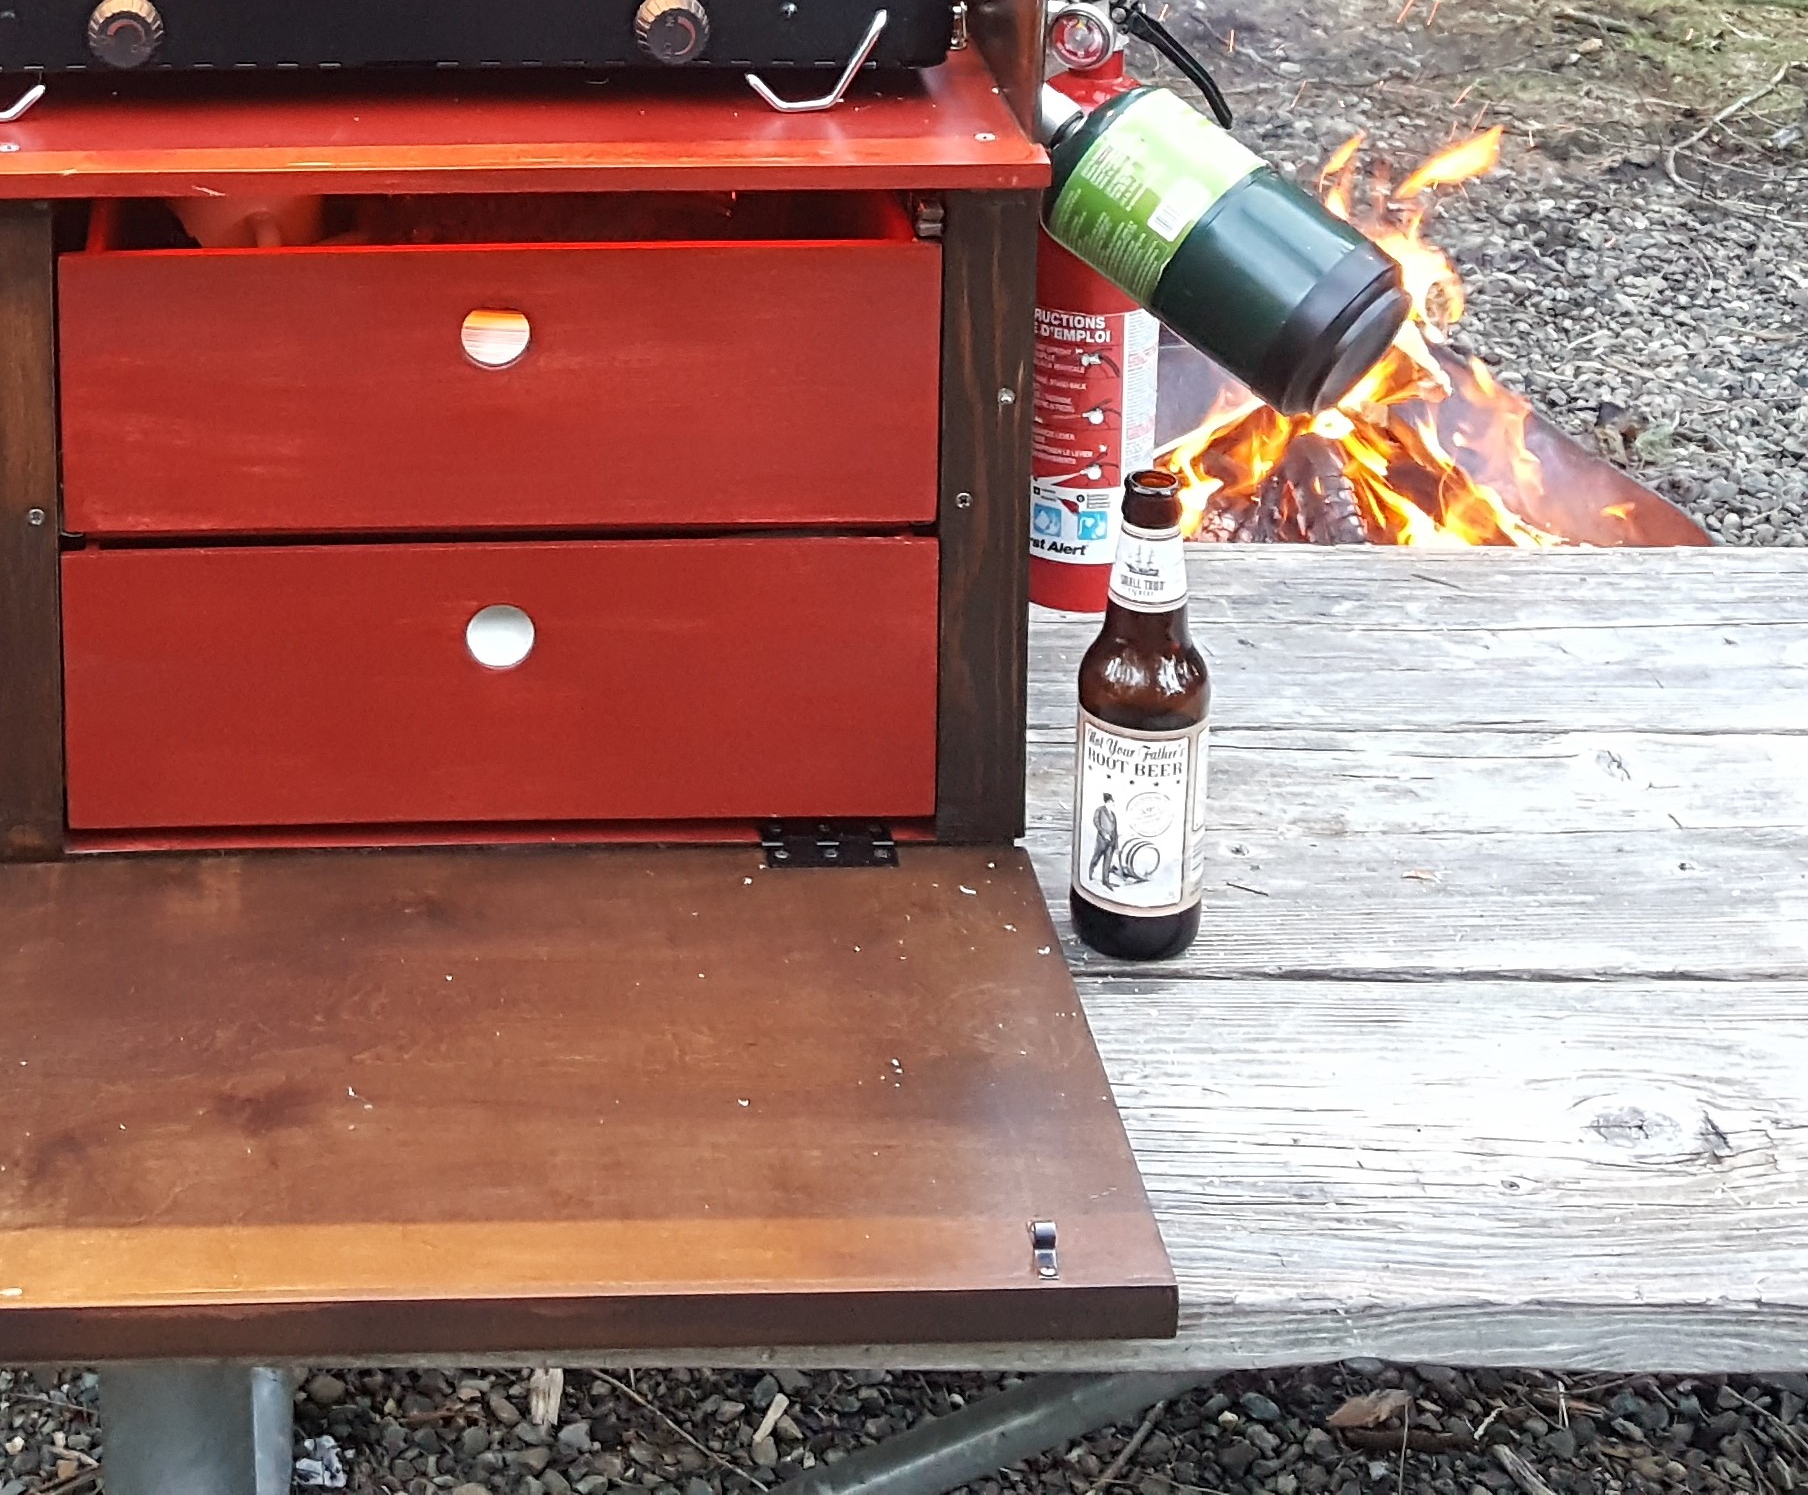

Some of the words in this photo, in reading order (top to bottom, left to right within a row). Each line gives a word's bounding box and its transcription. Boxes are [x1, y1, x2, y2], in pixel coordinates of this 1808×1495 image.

[1041, 324, 1110, 343] D'EMPLOI
[1047, 540, 1086, 555] Alert
[1106, 738, 1135, 757] Your
[1138, 744, 1185, 762] Father's
[1088, 747, 1129, 773] ROOT
[1135, 762, 1183, 777] BEER
